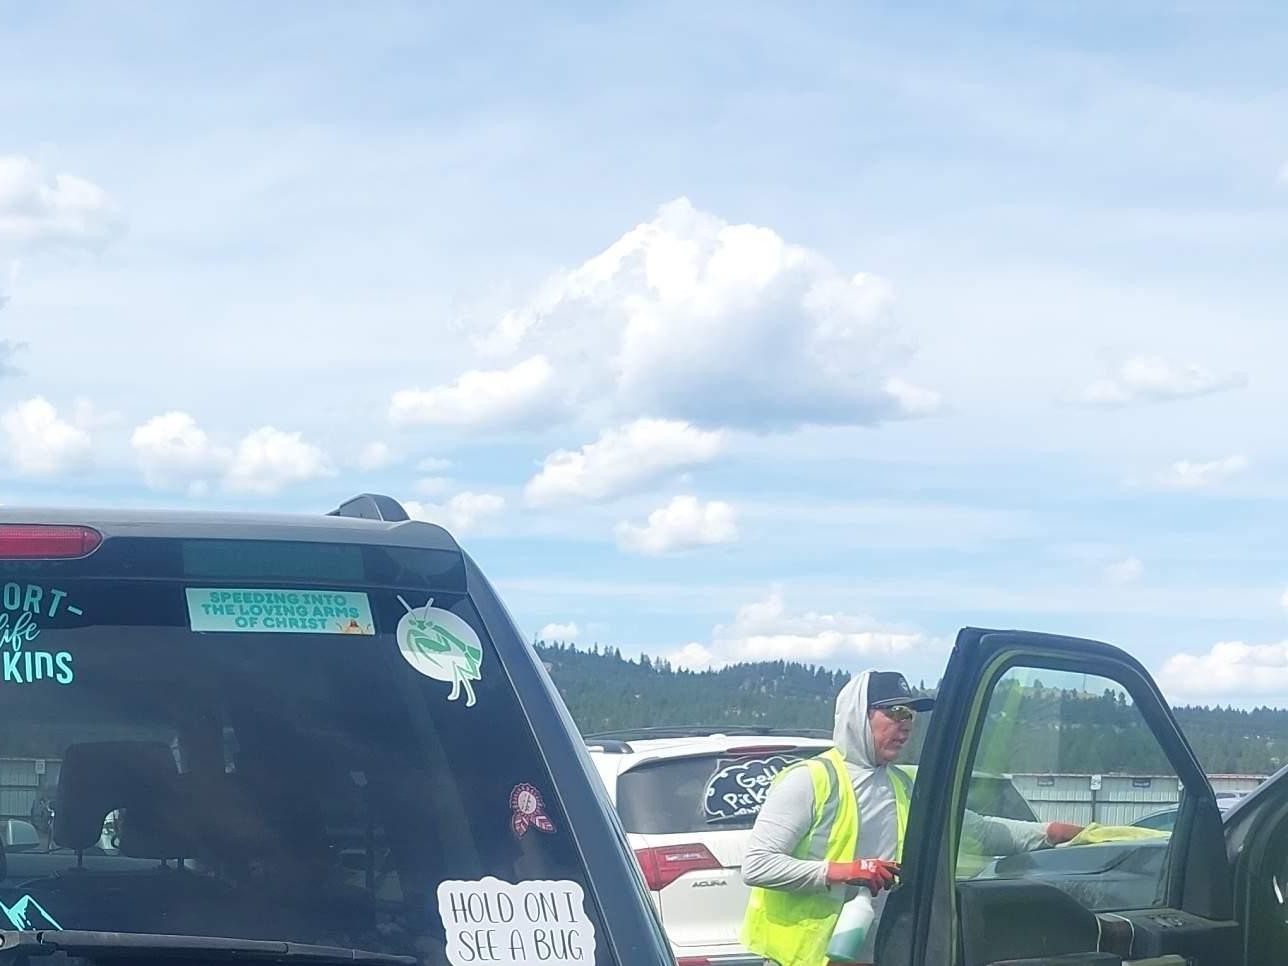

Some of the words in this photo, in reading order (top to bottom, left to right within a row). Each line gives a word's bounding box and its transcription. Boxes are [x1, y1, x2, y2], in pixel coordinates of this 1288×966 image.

[209, 591, 299, 605] SPEEDING
[302, 593, 347, 606] INTO
[201, 604, 235, 615] THE
[240, 604, 308, 617] LOVING
[312, 606, 360, 619] ARMS
[235, 616, 259, 628] OF
[263, 616, 328, 630] CHRIST
[691, 880, 728, 888] ACURA
[449, 892, 514, 923] HOLD
[524, 892, 559, 923] ON
[562, 892, 579, 923] I
[458, 929, 501, 961] SEE
[508, 929, 527, 960] A
[533, 928, 584, 961] BUG
